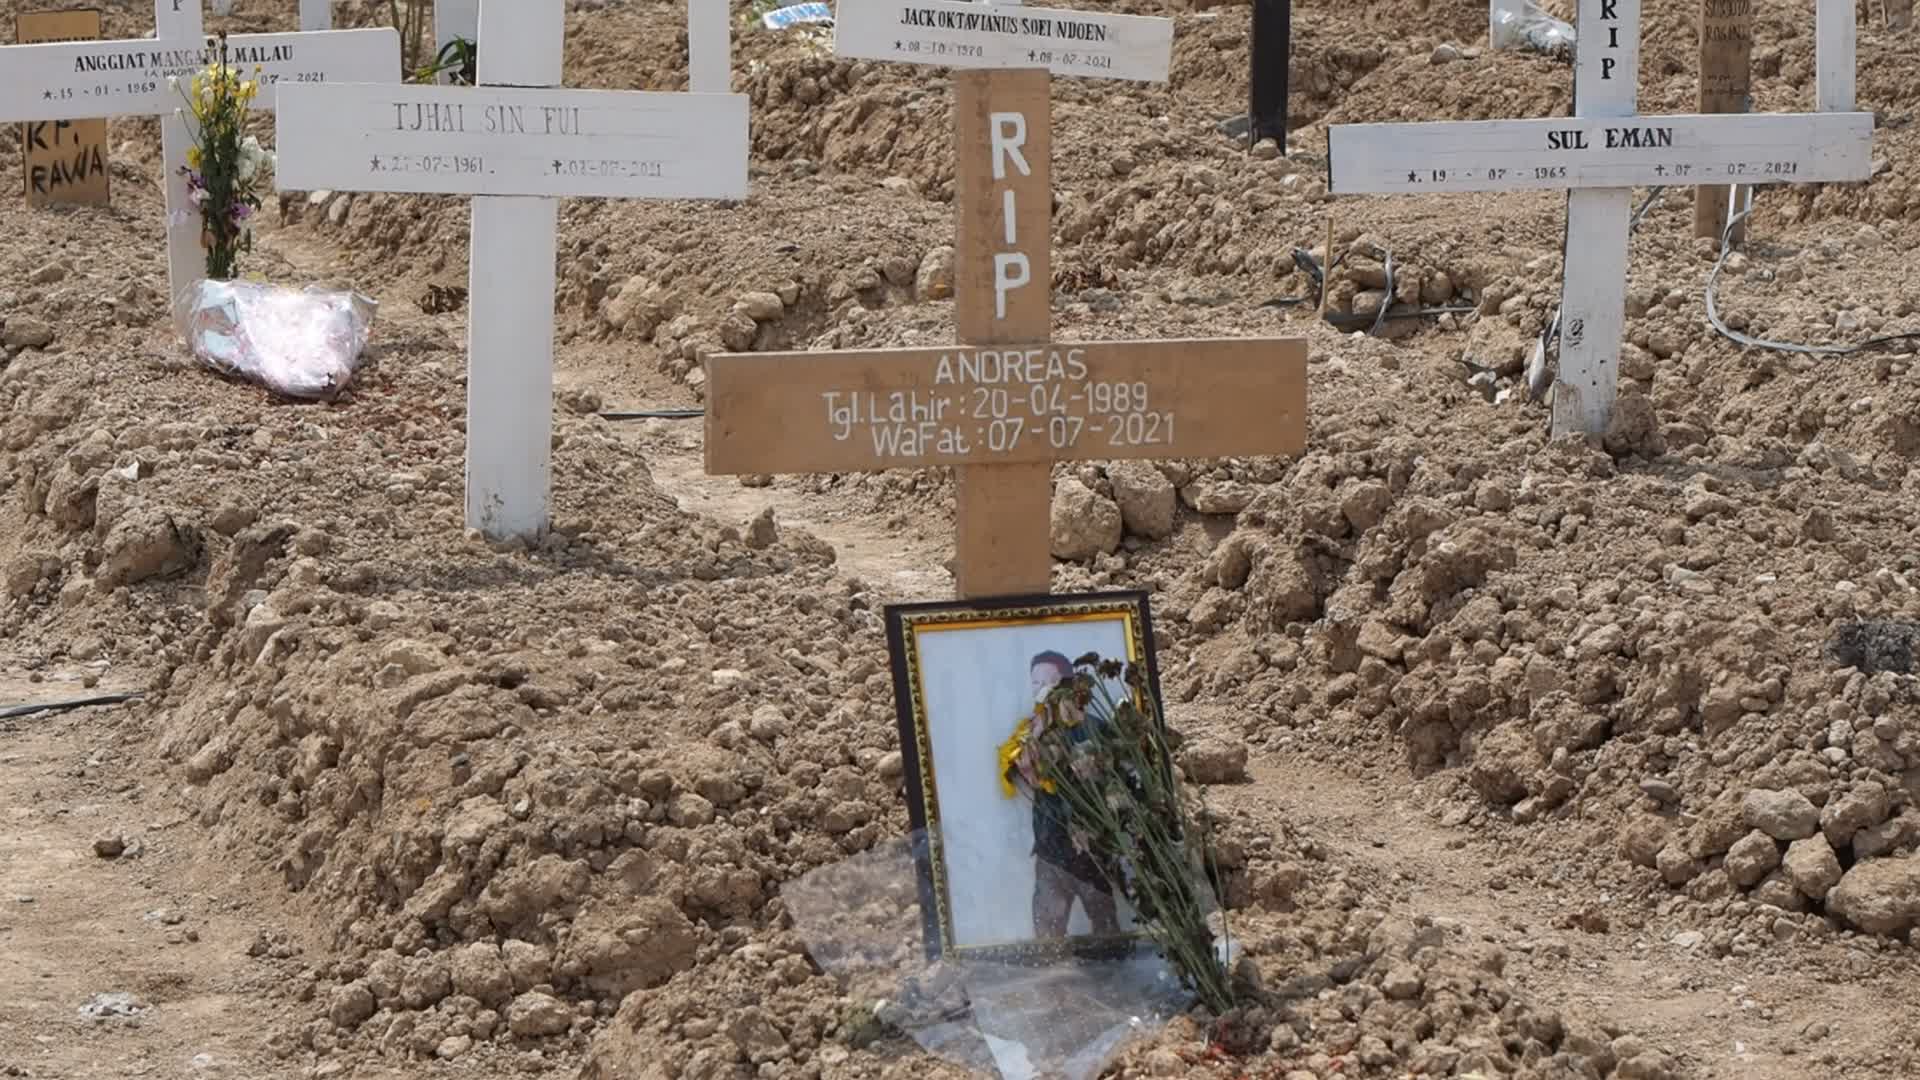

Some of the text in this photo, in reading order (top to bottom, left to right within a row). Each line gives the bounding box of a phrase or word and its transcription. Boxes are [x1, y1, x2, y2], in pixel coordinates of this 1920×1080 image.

[901, 8, 936, 27] JACK
[938, 11, 1018, 34] OKTAVIANUS
[1057, 21, 1106, 41] NDOEN
[75, 52, 146, 72] ANGGIAT
[234, 45, 293, 63] MALAU
[485, 105, 525, 133] SIN
[541, 106, 581, 135] FUI
[1547, 127, 1672, 150] SUL EMAN
[31, 144, 103, 194] RAWA
[990, 111, 1031, 319] RIP
[935, 349, 1087, 384] ANDREAS
